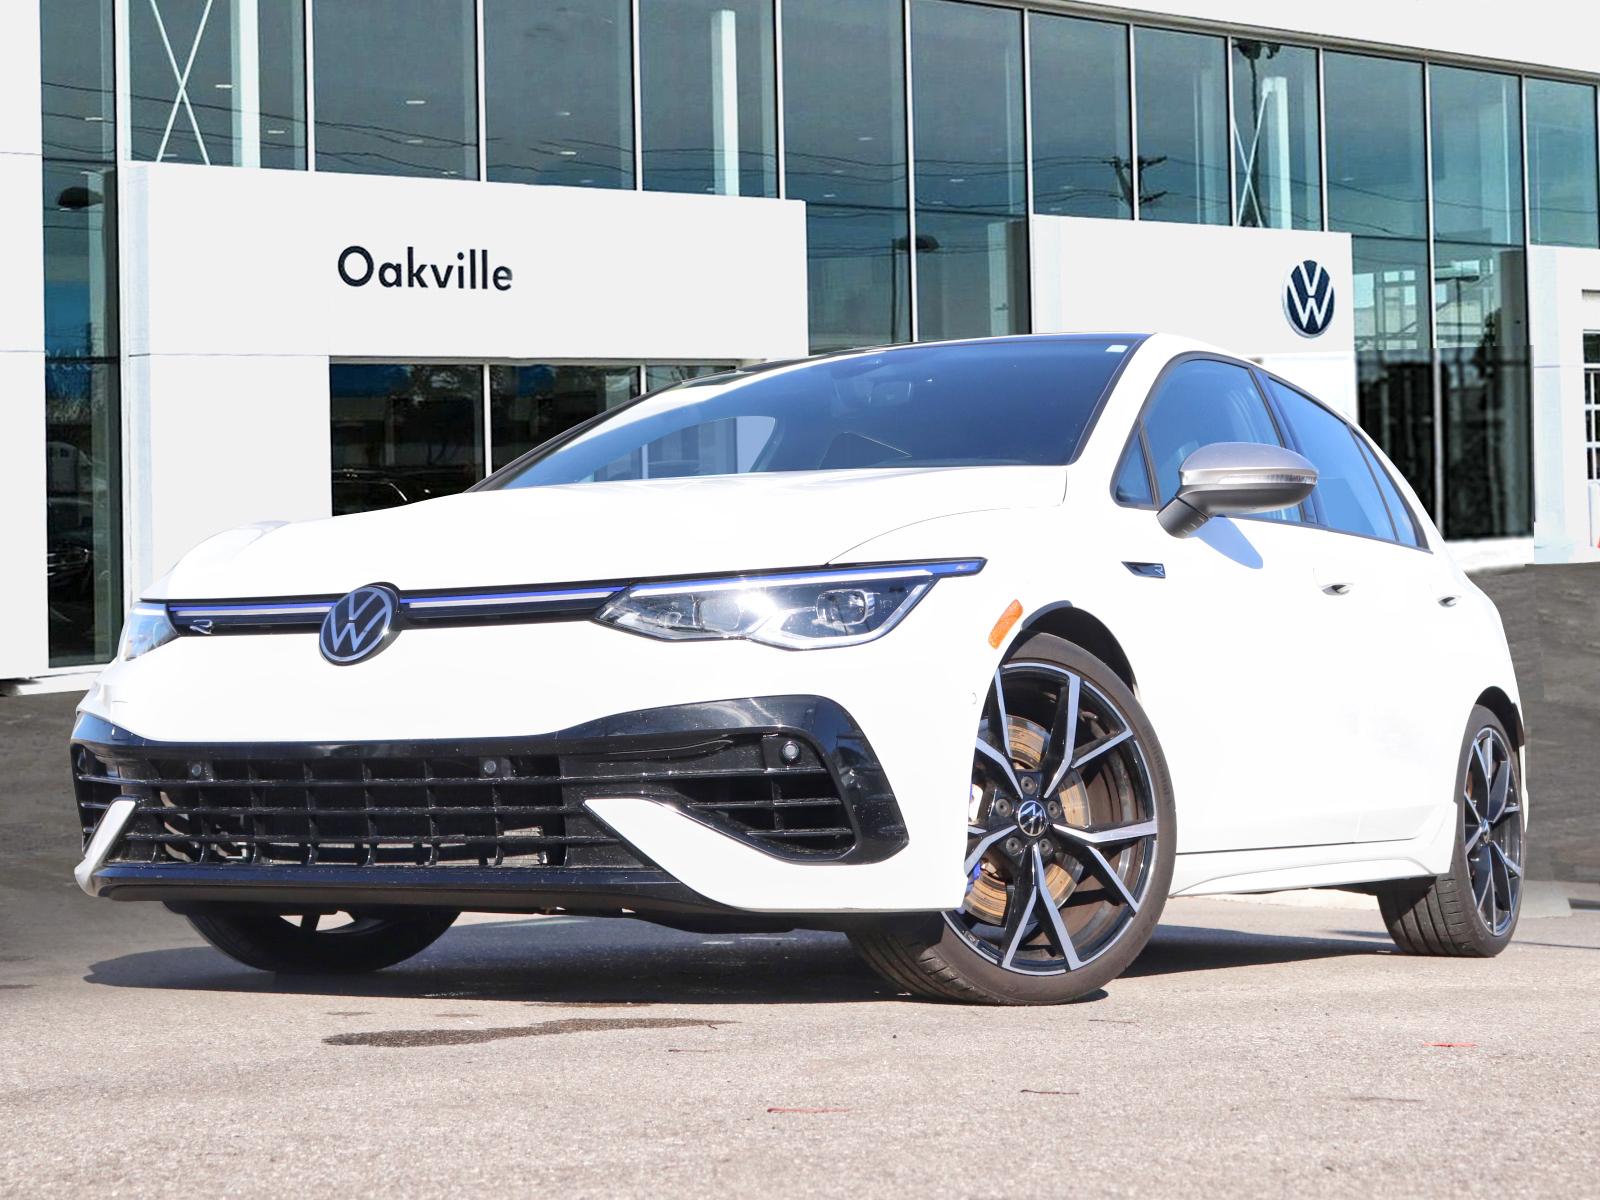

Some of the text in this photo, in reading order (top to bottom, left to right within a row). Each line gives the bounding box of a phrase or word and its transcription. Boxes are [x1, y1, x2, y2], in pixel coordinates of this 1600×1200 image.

[338, 245, 513, 291] Oakville
[1284, 259, 1335, 334] VW
[324, 587, 391, 659] VW
